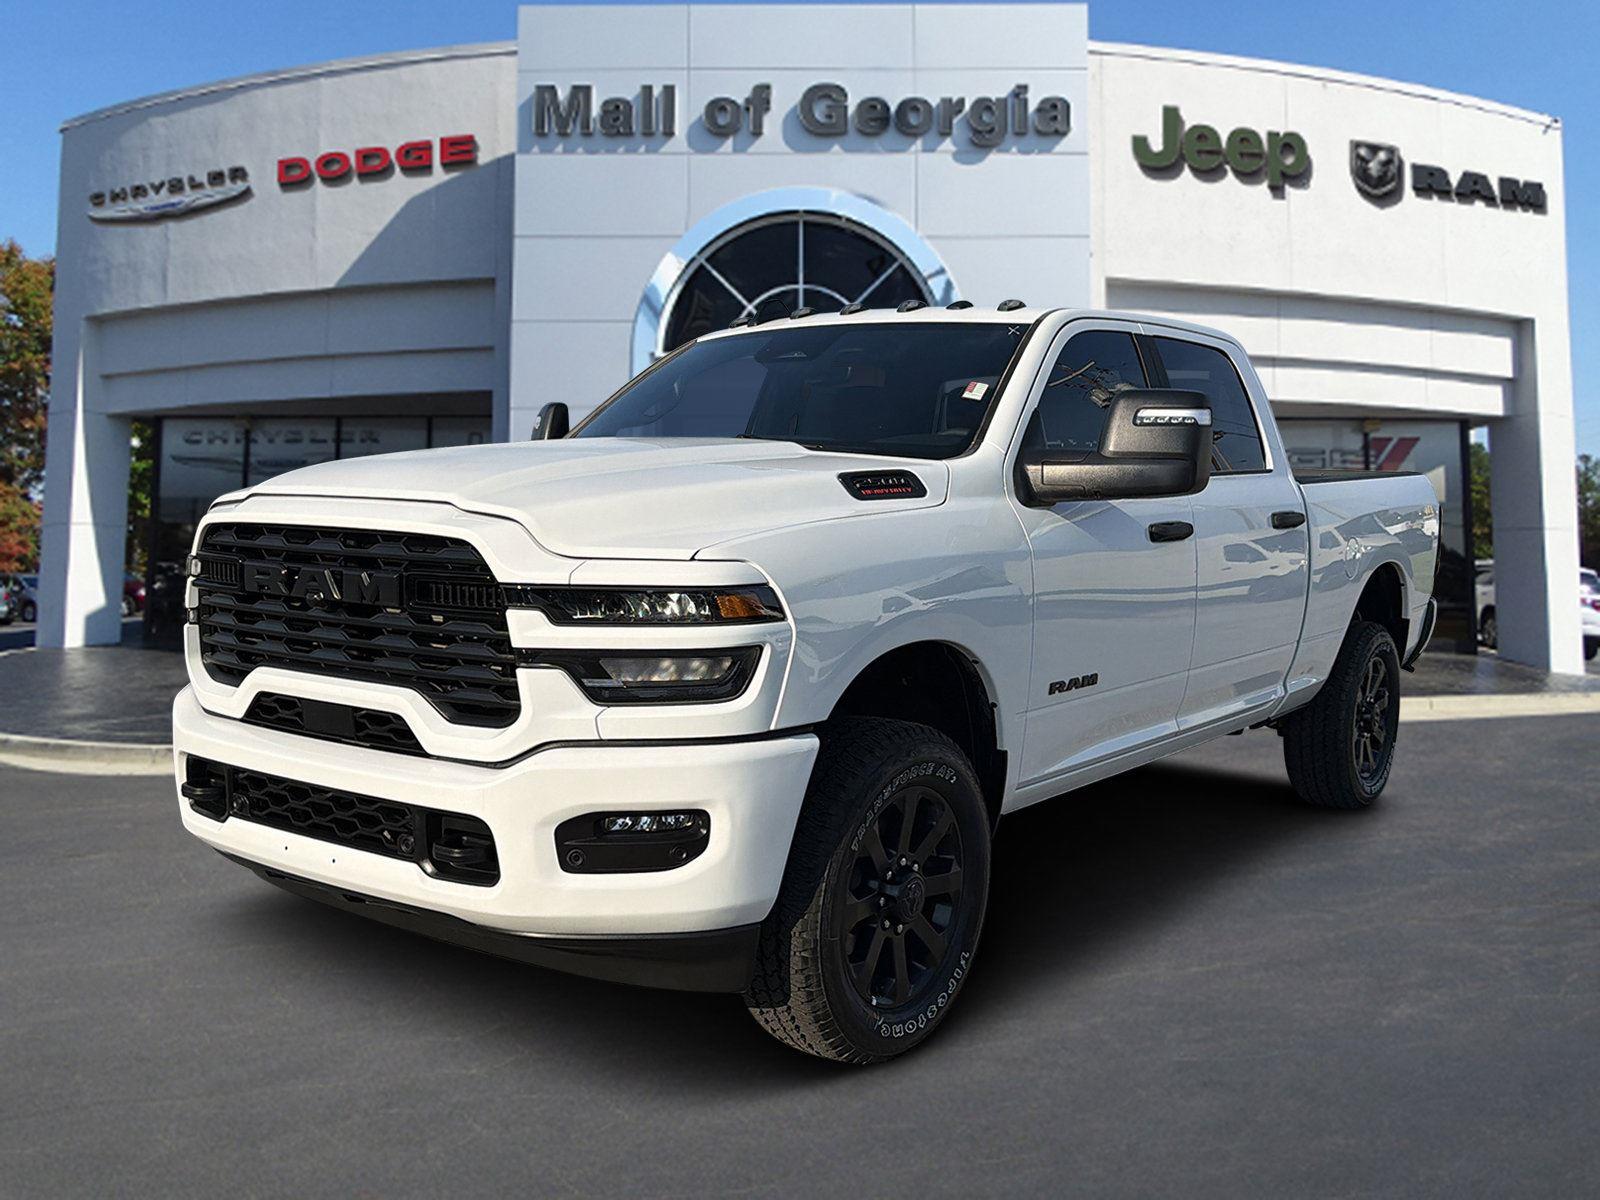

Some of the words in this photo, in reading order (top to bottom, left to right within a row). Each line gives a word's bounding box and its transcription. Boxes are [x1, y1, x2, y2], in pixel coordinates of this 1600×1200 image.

[533, 84, 677, 138] Mall
[704, 83, 772, 138] of
[799, 82, 1073, 149] Georgia
[277, 134, 477, 186] DODGE
[1132, 105, 1309, 190] Jeep
[89, 166, 249, 207] CHRYSLER
[1411, 163, 1547, 214] RAM
[244, 560, 402, 608] RAM
[1048, 672, 1099, 696] RAM
